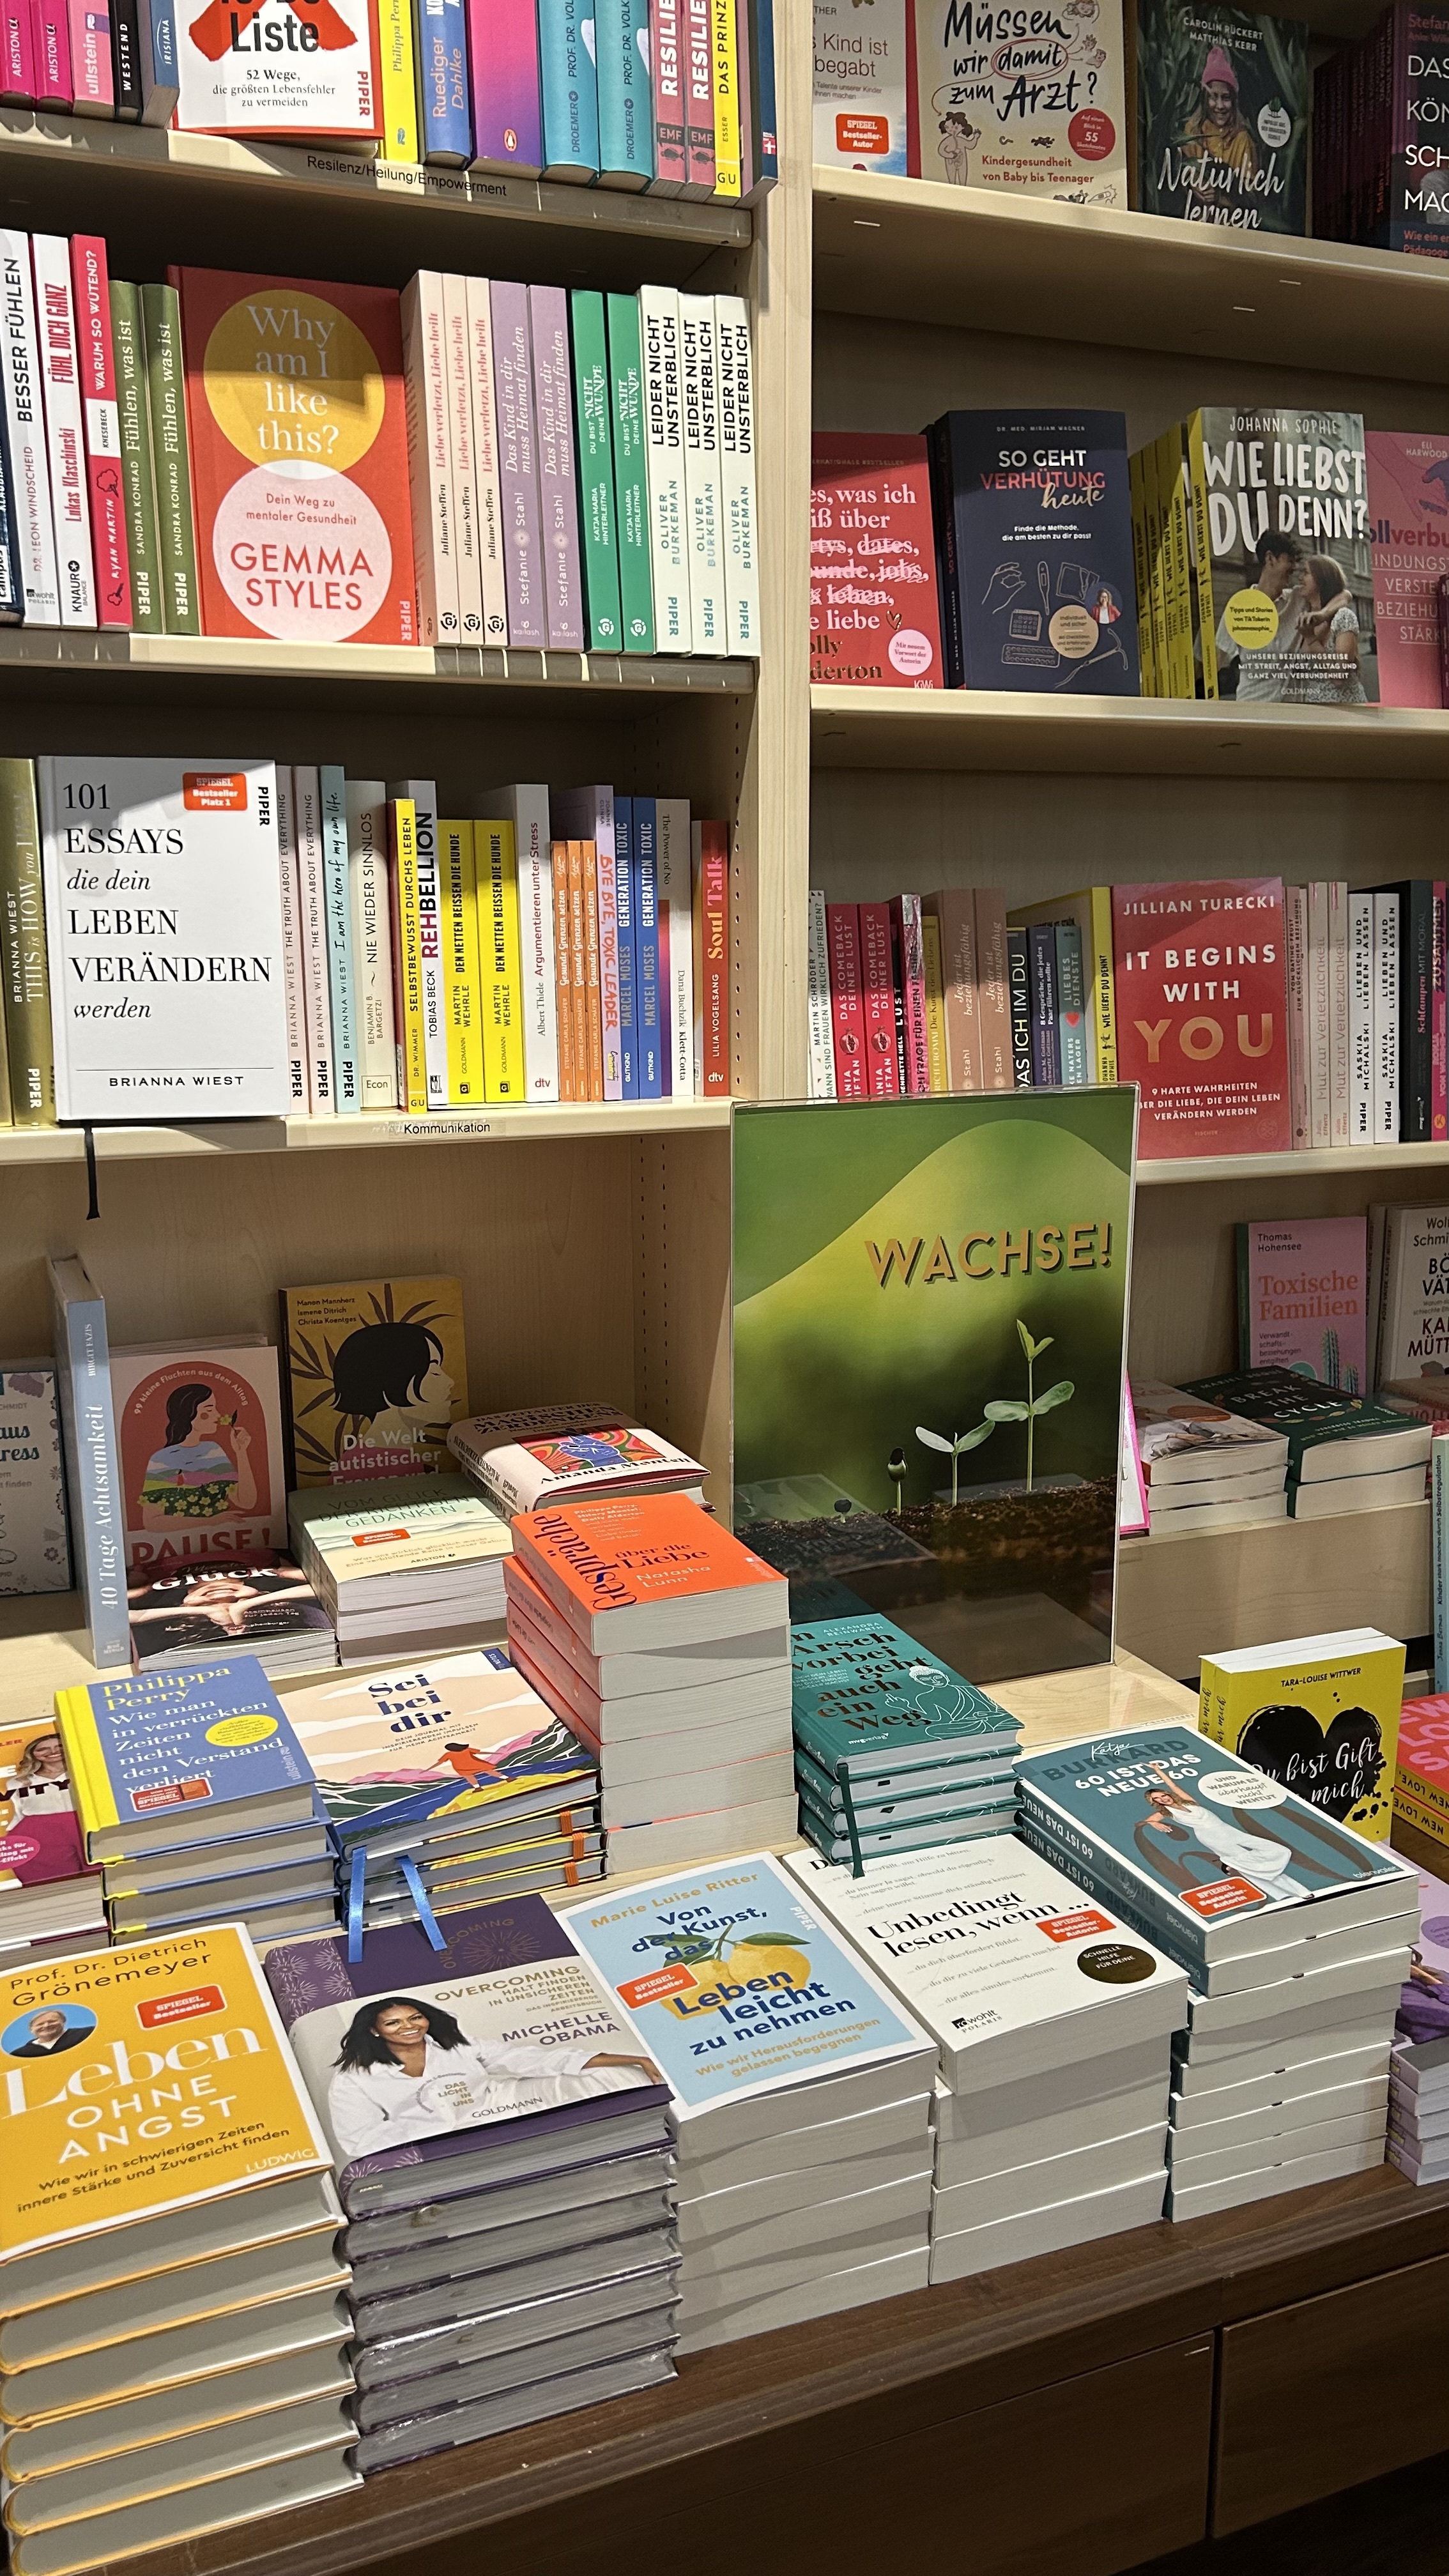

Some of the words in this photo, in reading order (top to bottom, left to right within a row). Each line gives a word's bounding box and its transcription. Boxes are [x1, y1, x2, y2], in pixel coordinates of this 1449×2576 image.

[231, 12, 319, 52] Liste
[944, 0, 1072, 48] Müssen
[1183, 17, 1222, 33] CAROLIN
[1225, 23, 1263, 40] RÜCKERT
[1190, 31, 1232, 47] MATTHIAS
[1235, 40, 1257, 52] KERR
[122, 23, 132, 91] WESTEND
[953, 50, 988, 76] wir
[999, 44, 1062, 71] damit
[247, 70, 262, 80] 52
[264, 69, 300, 82] Wege,
[432, 36, 448, 118] Ruediger
[452, 48, 464, 109] Dahlke
[213, 85, 227, 95] die
[231, 85, 270, 98] größten
[273, 84, 335, 95] Lebensfehler
[242, 98, 253, 107] zu
[257, 96, 308, 107] vermeiden
[356, 70, 370, 116] PIPER
[949, 84, 994, 104] zum
[997, 70, 1098, 121] Arzt?
[843, 131, 882, 140] Bestseller-
[847, 120, 877, 130] SPIEGEL
[1085, 132, 1098, 142] 55
[853, 140, 873, 149] Autor
[307, 155, 507, 196] Resilenz/Heilung/Empowerment
[982, 156, 1072, 167] Kindergesundheit
[1158, 147, 1285, 197] Natürlich
[983, 173, 1000, 182] von
[1003, 172, 1027, 184] Baby
[1031, 172, 1045, 183] bis
[1048, 172, 1094, 185] Teenager
[1184, 190, 1262, 229] lernen
[84, 250, 100, 314] WÜTEND?
[3, 258, 26, 340] FÜHLEN
[91, 319, 102, 337] SO
[247, 305, 335, 348] Why
[647, 314, 661, 376] NICHT
[90, 339, 106, 392] WARUM
[256, 349, 307, 378] am
[311, 349, 328, 379] I
[12, 346, 33, 422] BESSER
[663, 316, 680, 447] UNSTERBLICH
[264, 381, 328, 417] like
[650, 379, 664, 446] LEIDER
[257, 422, 340, 456] this?
[1229, 416, 1288, 433] JOHANNA
[1295, 418, 1338, 435] SOPHIE
[999, 450, 1027, 468] SO
[1033, 450, 1087, 466] GEHT
[1202, 441, 1267, 488] WIE
[1273, 442, 1366, 494] LIEBST
[981, 468, 1105, 490] VERHÜTUNG
[266, 494, 289, 506] Dein
[293, 495, 321, 510] Weg
[323, 498, 335, 508] zu
[1040, 481, 1105, 509] heute
[247, 509, 293, 523] mentaler
[296, 512, 357, 526] Gesundheit
[659, 493, 670, 549] OLIVER
[668, 480, 680, 565] BURKEMAN
[1208, 490, 1270, 556] DU
[1278, 494, 1368, 540] DENN?
[230, 542, 374, 577] GEMMA
[246, 579, 362, 611] STYLES
[668, 597, 678, 636] PIPER
[63, 783, 112, 810] 101
[64, 828, 184, 855] ESSAYS
[530, 822, 540, 859] Stress
[66, 868, 99, 891] die
[106, 869, 151, 891] dein
[415, 812, 440, 959] REHBELLION
[532, 861, 540, 889] unter
[705, 855, 723, 906] Talk
[1123, 902, 1193, 916] JILLIAN
[1200, 896, 1275, 911] TURECKI
[68, 909, 179, 935] LEBEN
[530, 891, 544, 977] Argumentieren
[704, 907, 723, 961] Soul
[68, 951, 272, 983] VERÄNDERN
[1126, 951, 1151, 971] IT
[1165, 944, 1276, 969] BEGINS
[1163, 981, 1240, 1002] WITH
[73, 997, 152, 1020] werden
[1133, 1013, 1273, 1063] YOU
[109, 1076, 185, 1087] BRIANNA
[192, 1076, 244, 1086] WIEST
[1154, 1107, 1213, 1121] VERÄNDERN
[1216, 1107, 1257, 1117] WERDEN
[404, 1121, 491, 1136] Kommunikation
[1257, 1232, 1292, 1242] Thomas
[1258, 1242, 1302, 1252] Hohensee
[864, 1222, 1114, 1290] WACHSE!
[1259, 1269, 1358, 1297] Toxische
[1259, 1296, 1358, 1322] Familien
[343, 1434, 376, 1450] Die
[381, 1429, 427, 1446] Welt
[88, 1403, 113, 1531] Achtsamkeit
[328, 1448, 441, 1472] autistischer
[99, 1535, 118, 1583] Tage
[614, 1550, 710, 1569] Liebe
[615, 1547, 657, 1560] über
[663, 1543, 691, 1552] die
[636, 1565, 710, 1583] Natasha
[642, 1575, 688, 1588] Lunn
[100, 1585, 118, 1610] 40
[792, 1632, 898, 1656] Arsch
[102, 1666, 232, 1700] Philippa
[368, 1674, 431, 1699] Sei
[817, 1679, 903, 1703] auch
[1281, 1673, 1328, 1688] TARA-LOUISE
[1330, 1667, 1361, 1681] WITTWER
[107, 1689, 191, 1712] Perry
[109, 1711, 157, 1726] Wie
[165, 1700, 216, 1717] man
[376, 1689, 443, 1717] bei
[817, 1701, 876, 1719] ein
[112, 1728, 137, 1739] in
[144, 1700, 268, 1731] verrückten
[390, 1709, 452, 1735] dir
[843, 1710, 932, 1731] Weg
[115, 1730, 191, 1752] Zeiten
[118, 1747, 182, 1766] nicht
[1075, 1772, 1104, 1790] 60
[1108, 1763, 1147, 1782] IST
[1149, 1754, 1202, 1771] DAS
[1097, 1774, 1165, 1797] NEUE
[1170, 1767, 1199, 1782] 60
[591, 1903, 647, 1928] Marie
[651, 1887, 702, 1908] Luise
[706, 1873, 759, 1892] Ritter
[657, 1905, 712, 1927] Von
[865, 1890, 1026, 1940] Unbedingt
[631, 1927, 684, 1954] der
[680, 1906, 768, 1937] Kunst,
[881, 1920, 977, 1959] lesen,
[975, 1901, 1062, 1929] wenn
[10, 1968, 67, 1990] Prof.
[73, 1961, 105, 1975] Dr.
[114, 1938, 208, 1966] Dietrich
[665, 1938, 713, 1963] das
[13, 1952, 212, 2007] Grönemeyer
[434, 1965, 580, 2002] OVERCOMING
[672, 1969, 793, 2016] Leben
[718, 1981, 832, 2024] leicht
[501, 2011, 613, 2043] MICHELLE
[539, 2022, 621, 2046] OBAMA
[689, 2034, 727, 2056] zu
[733, 1998, 856, 2041] nehmen
[0, 2027, 270, 2119] Leben
[66, 2074, 217, 2129] OHNE
[471, 2097, 544, 2119] GOLDMANN
[58, 2096, 238, 2165] ANGST
[245, 2148, 316, 2174] LUDWIG
